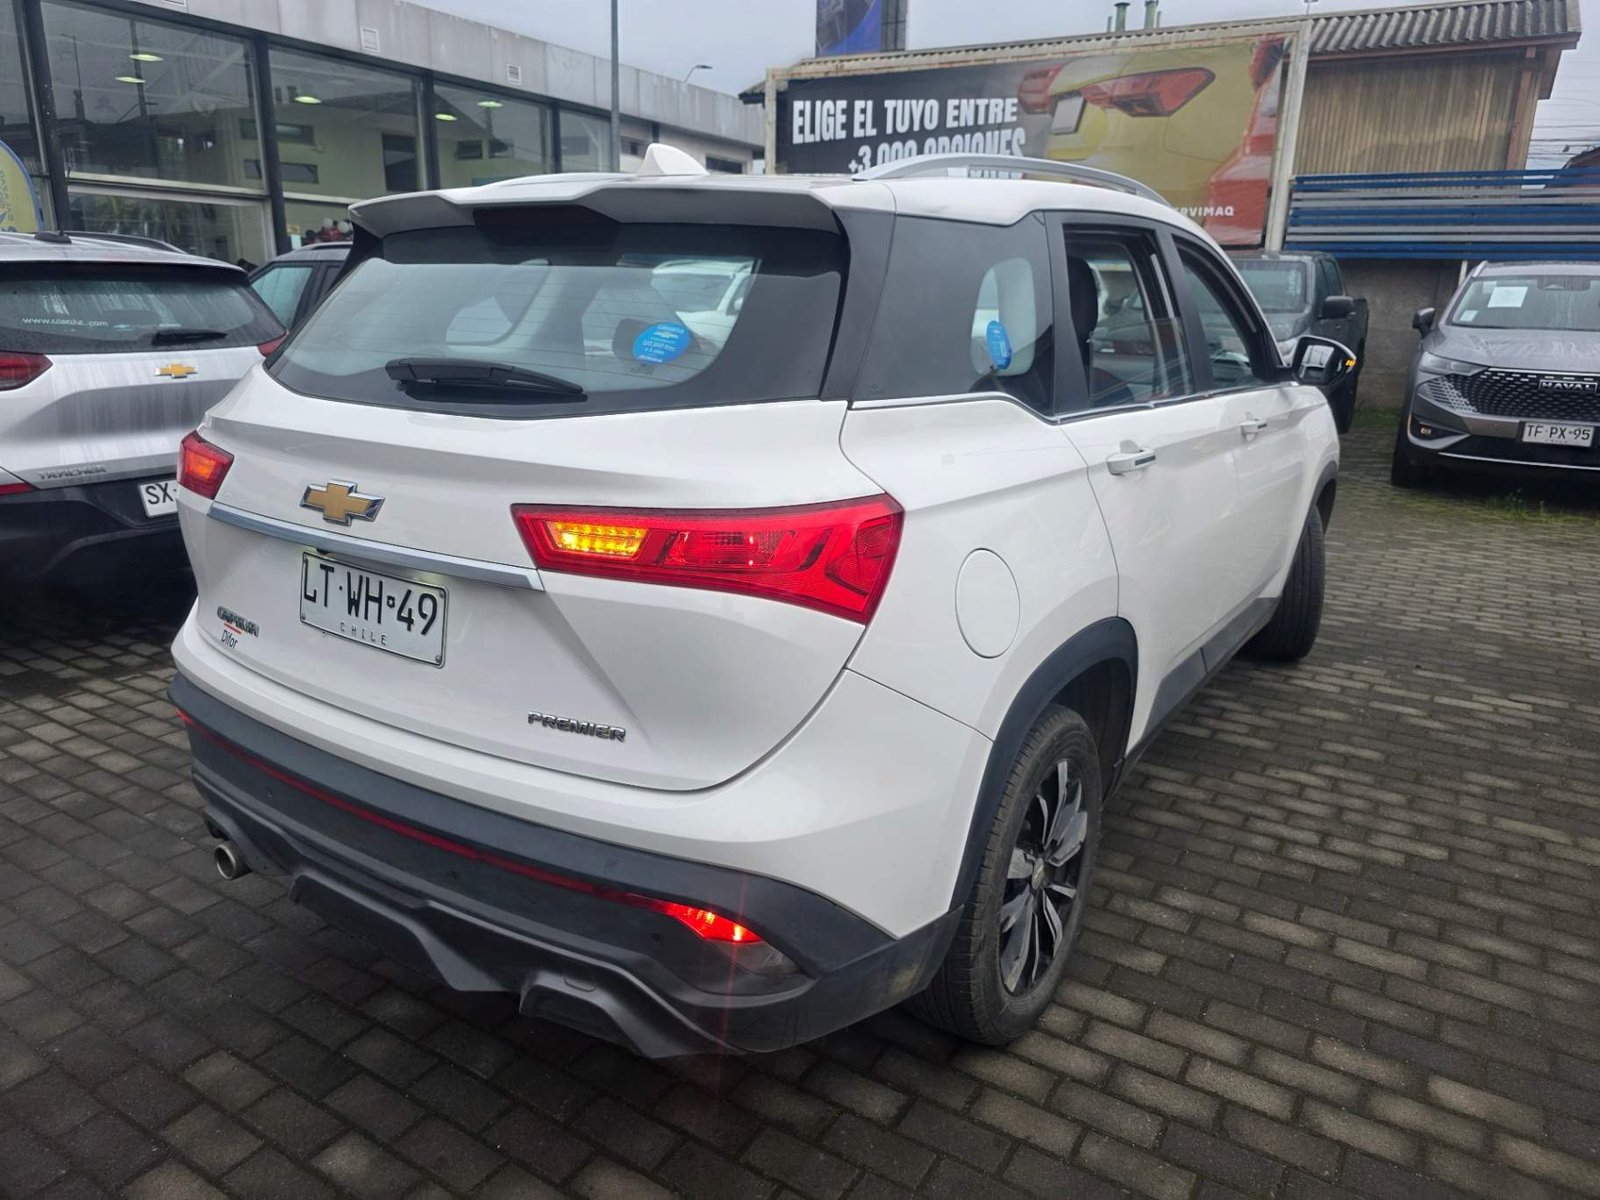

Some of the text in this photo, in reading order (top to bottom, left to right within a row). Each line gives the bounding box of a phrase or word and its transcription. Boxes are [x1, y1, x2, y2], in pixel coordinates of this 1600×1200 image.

[792, 97, 1019, 144] ELIGE EL TUYO ENTRE
[339, 620, 388, 646] CHILE
[527, 710, 626, 742] PREMIER
